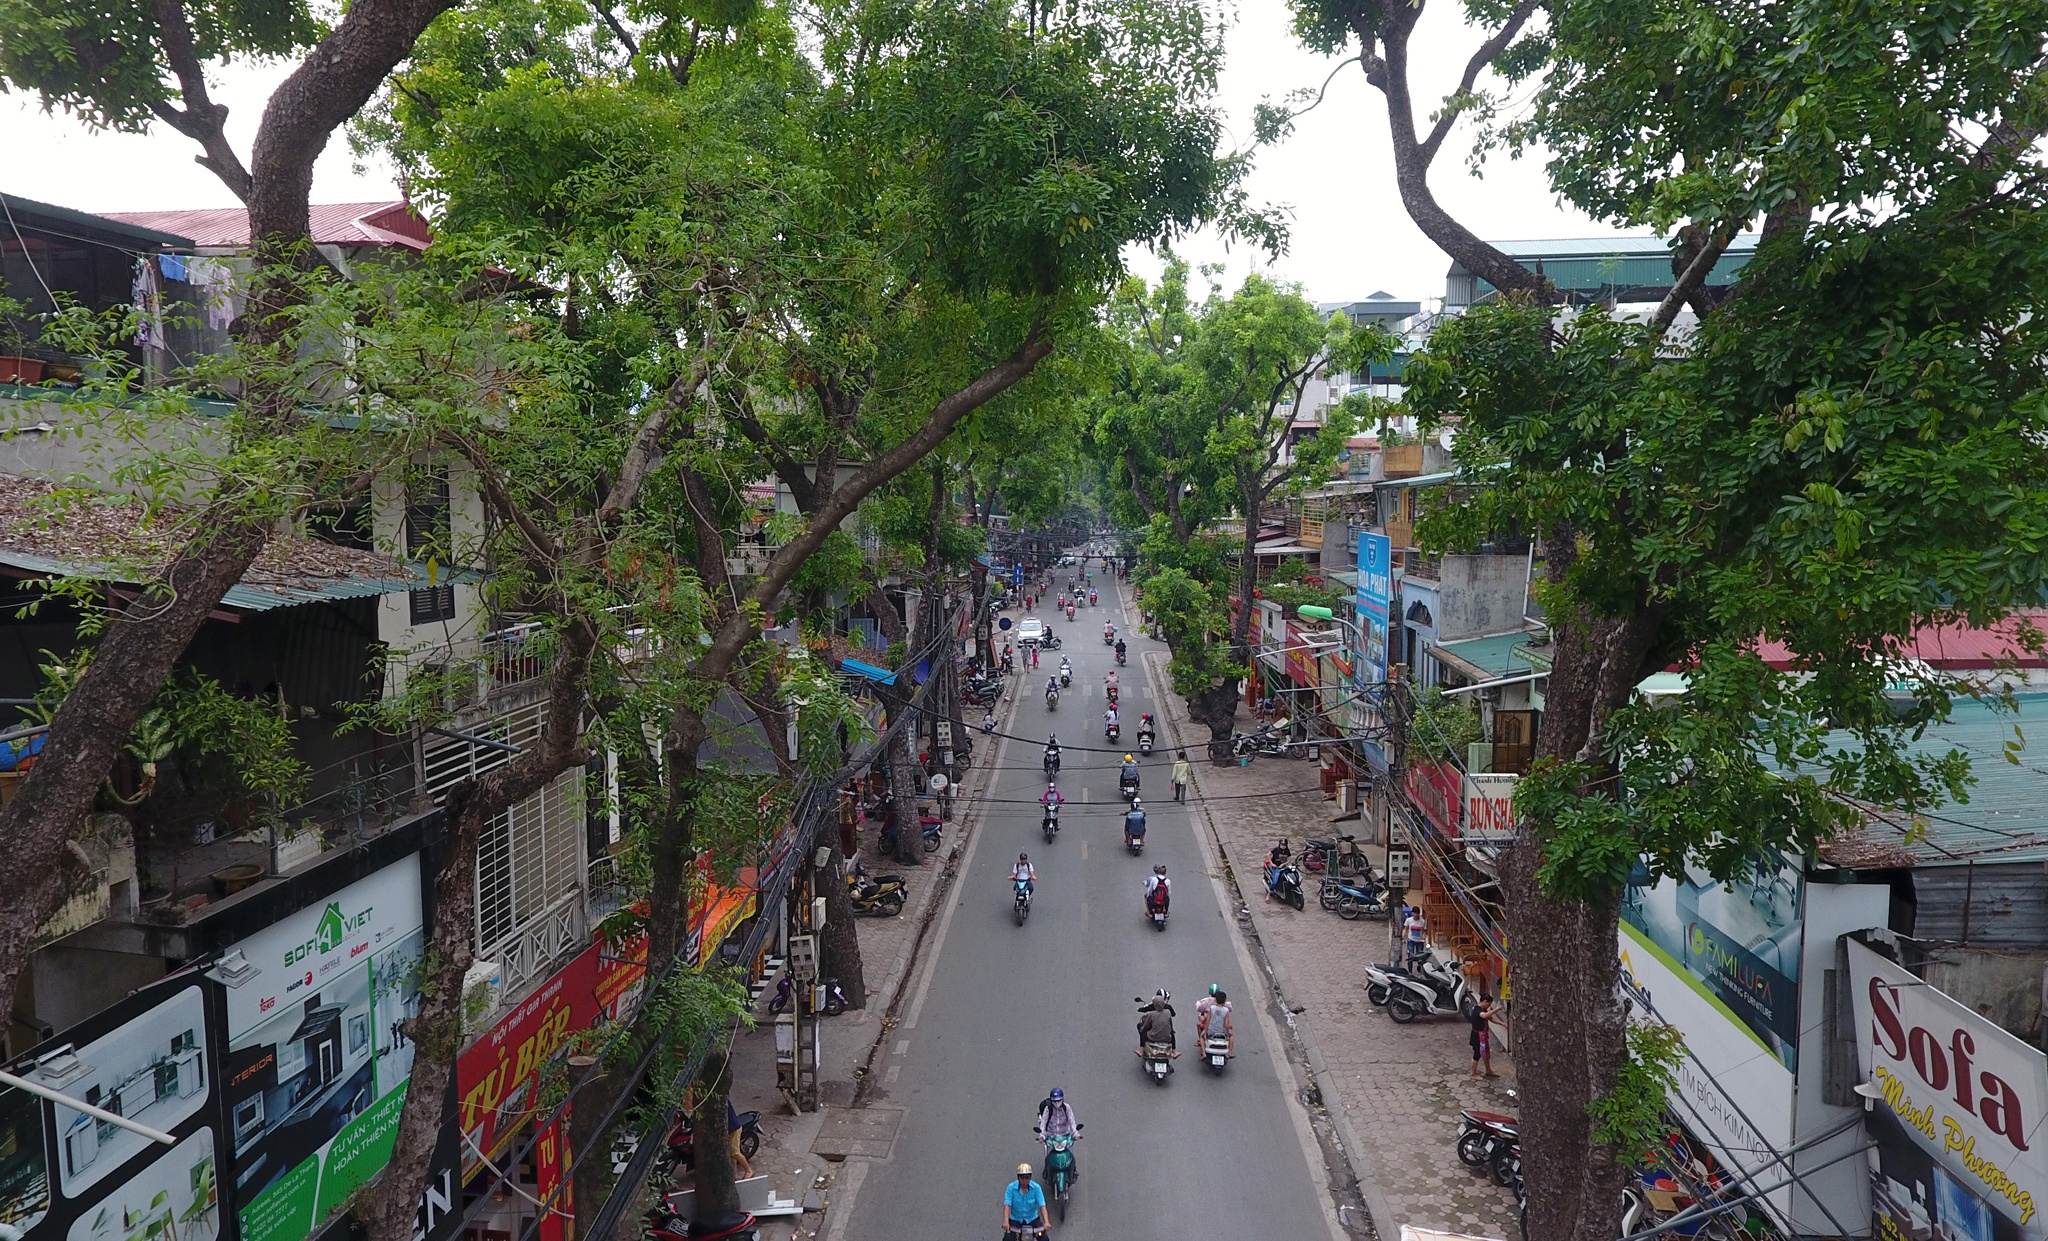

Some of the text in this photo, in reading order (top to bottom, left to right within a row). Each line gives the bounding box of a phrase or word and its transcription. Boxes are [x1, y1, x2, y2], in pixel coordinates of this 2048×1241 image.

[344, 906, 373, 932] VIET
[350, 942, 369, 958] blum
[1705, 938, 1773, 1005] FAMILUFA
[286, 979, 304, 993] FAGOR
[1705, 962, 1773, 1021] NEW THINKING FURNITURE
[461, 995, 571, 1136] TỦ BẾP
[1869, 976, 2029, 1151] Sofa
[1724, 1108, 1744, 1144] KIM
[1876, 1066, 1936, 1139] Minh
[1880, 1211, 1898, 1239] 962
